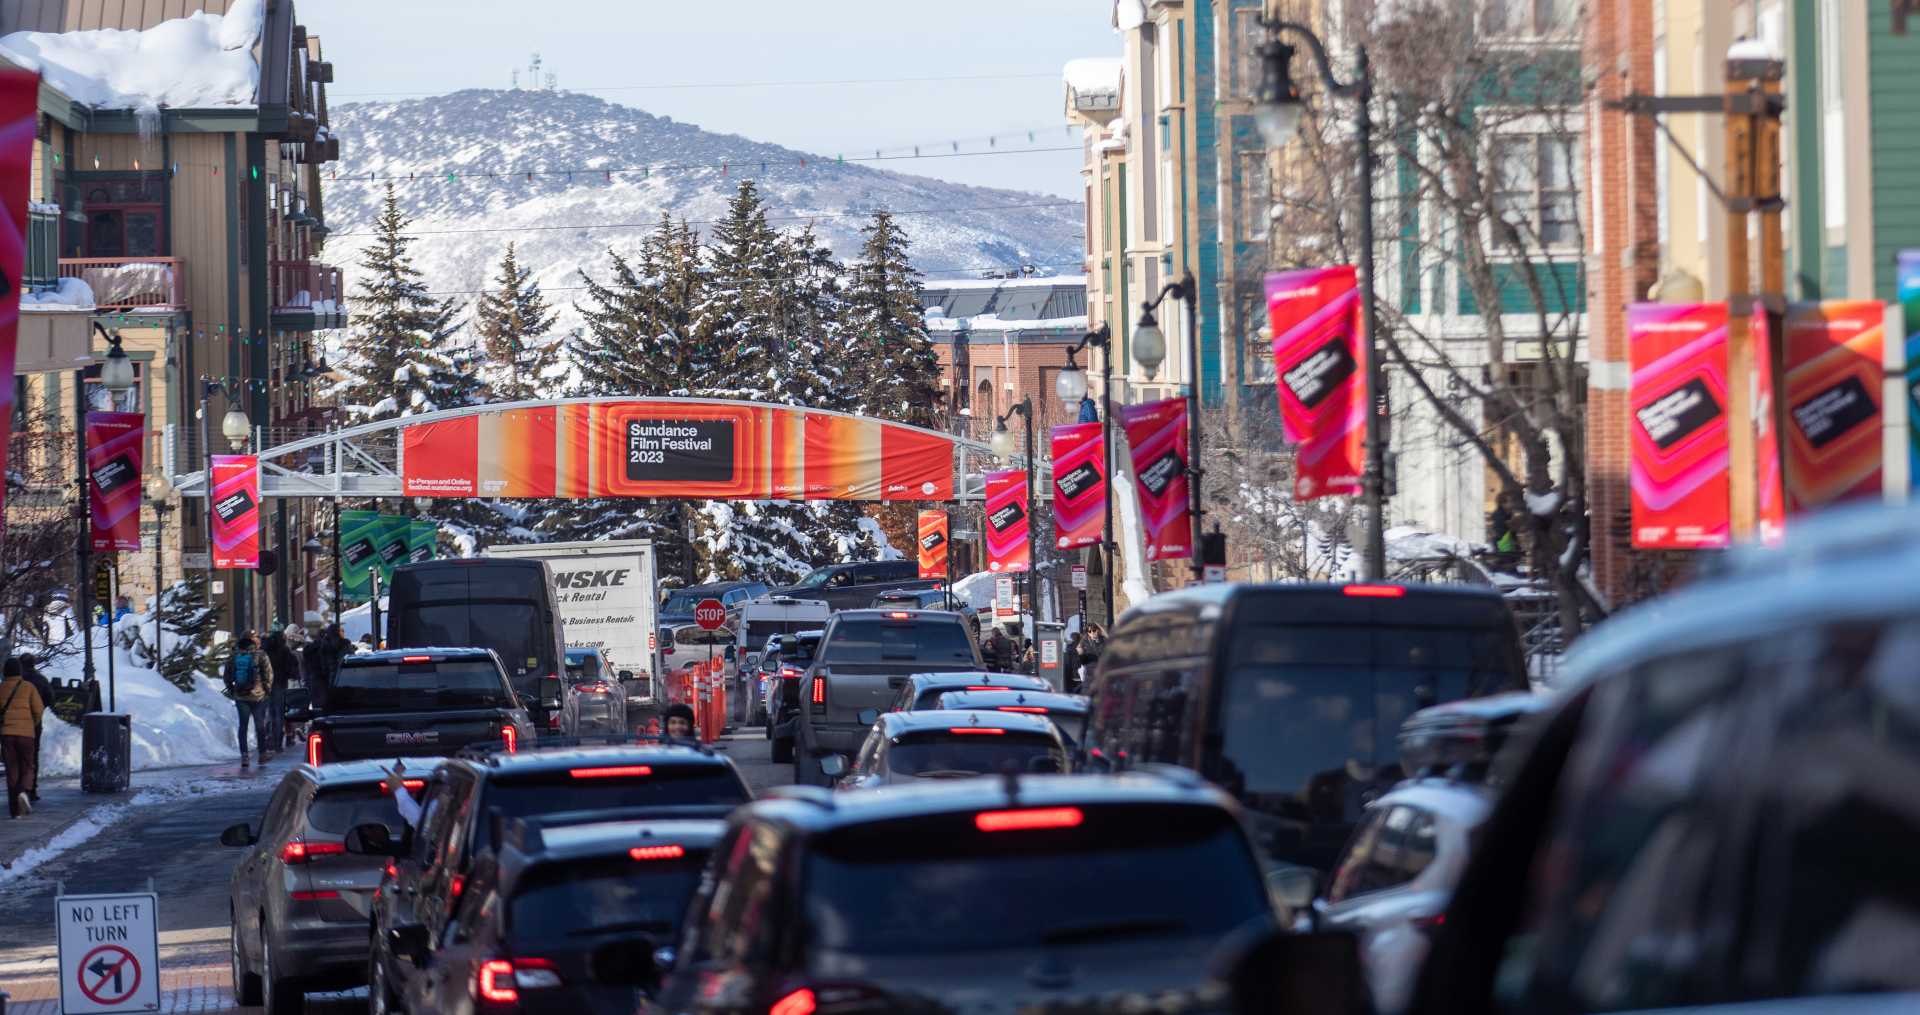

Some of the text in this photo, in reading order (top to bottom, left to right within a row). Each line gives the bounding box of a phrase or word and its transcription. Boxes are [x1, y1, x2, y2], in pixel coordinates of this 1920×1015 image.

[630, 424, 698, 436] Sundance
[630, 437, 712, 450] Film Festival
[630, 451, 664, 464] 2023
[554, 569, 630, 589] NSKE
[556, 590, 607, 602] ck Rental
[570, 616, 604, 625] Business
[606, 615, 634, 624] Rentals
[698, 609, 724, 620] STOP
[386, 731, 439, 744] GMC
[72, 904, 140, 922] NO LEFT
[86, 926, 128, 942] TURN
